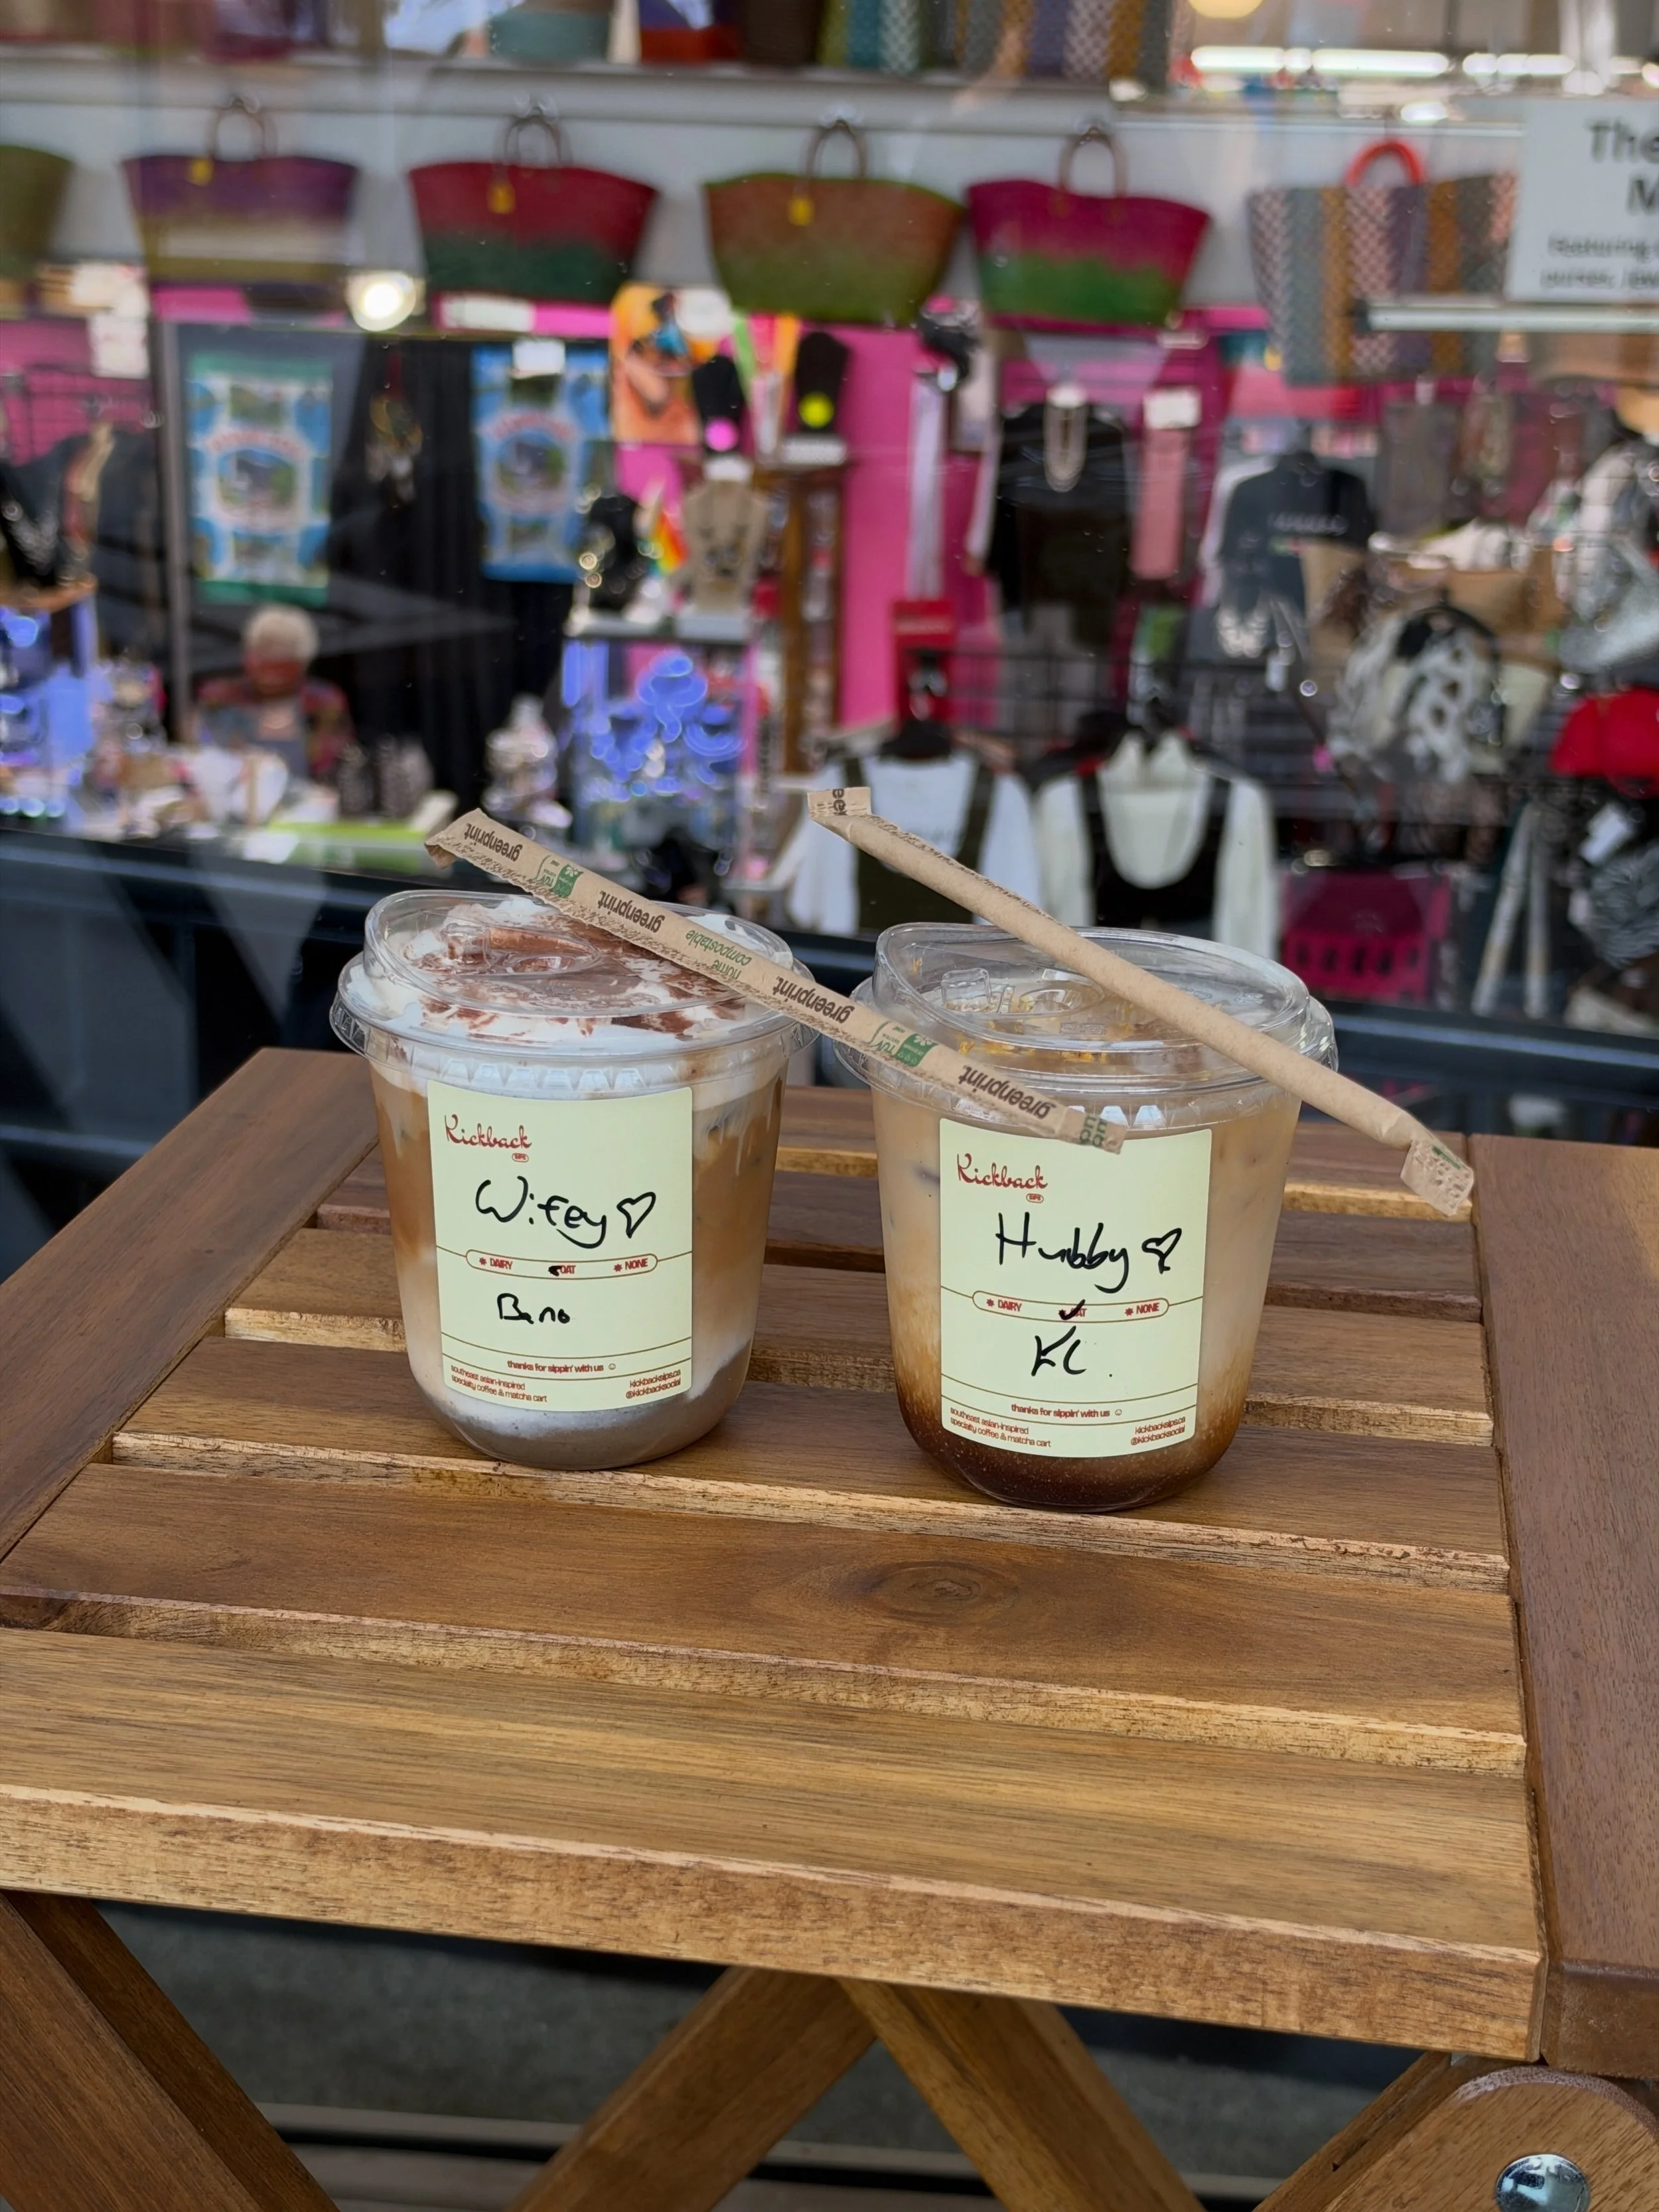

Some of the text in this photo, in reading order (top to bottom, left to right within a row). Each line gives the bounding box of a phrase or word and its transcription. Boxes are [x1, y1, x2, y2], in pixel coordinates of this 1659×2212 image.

[464, 823, 523, 862] greenprint
[597, 891, 666, 933] greenprint
[685, 929, 753, 966] compostable
[772, 976, 855, 1024] greenprint
[958, 1065, 1057, 1120] greenprint
[445, 1114, 532, 1149] Kickback
[957, 1153, 1048, 1189] Kickback
[475, 1175, 607, 1249] Wifey
[490, 1258, 648, 1274] DAIRY OAT NONE
[995, 1211, 1129, 1293] Hubby
[997, 1299, 1022, 1312] DAIRY
[1135, 1302, 1160, 1314] NONE
[451, 1364, 526, 1390] southeast asian-inspired
[507, 1361, 534, 1370] thanks
[575, 1364, 593, 1372] with
[451, 1374, 476, 1390] specialty
[477, 1384, 497, 1396] coffee
[505, 1392, 532, 1401] matcha
[950, 1407, 1029, 1435] southeast asian-inspired
[1011, 1404, 1039, 1415] thanks
[1040, 1408, 1052, 1416] for
[950, 1417, 1051, 1447] specialty coffee & matcha cart
